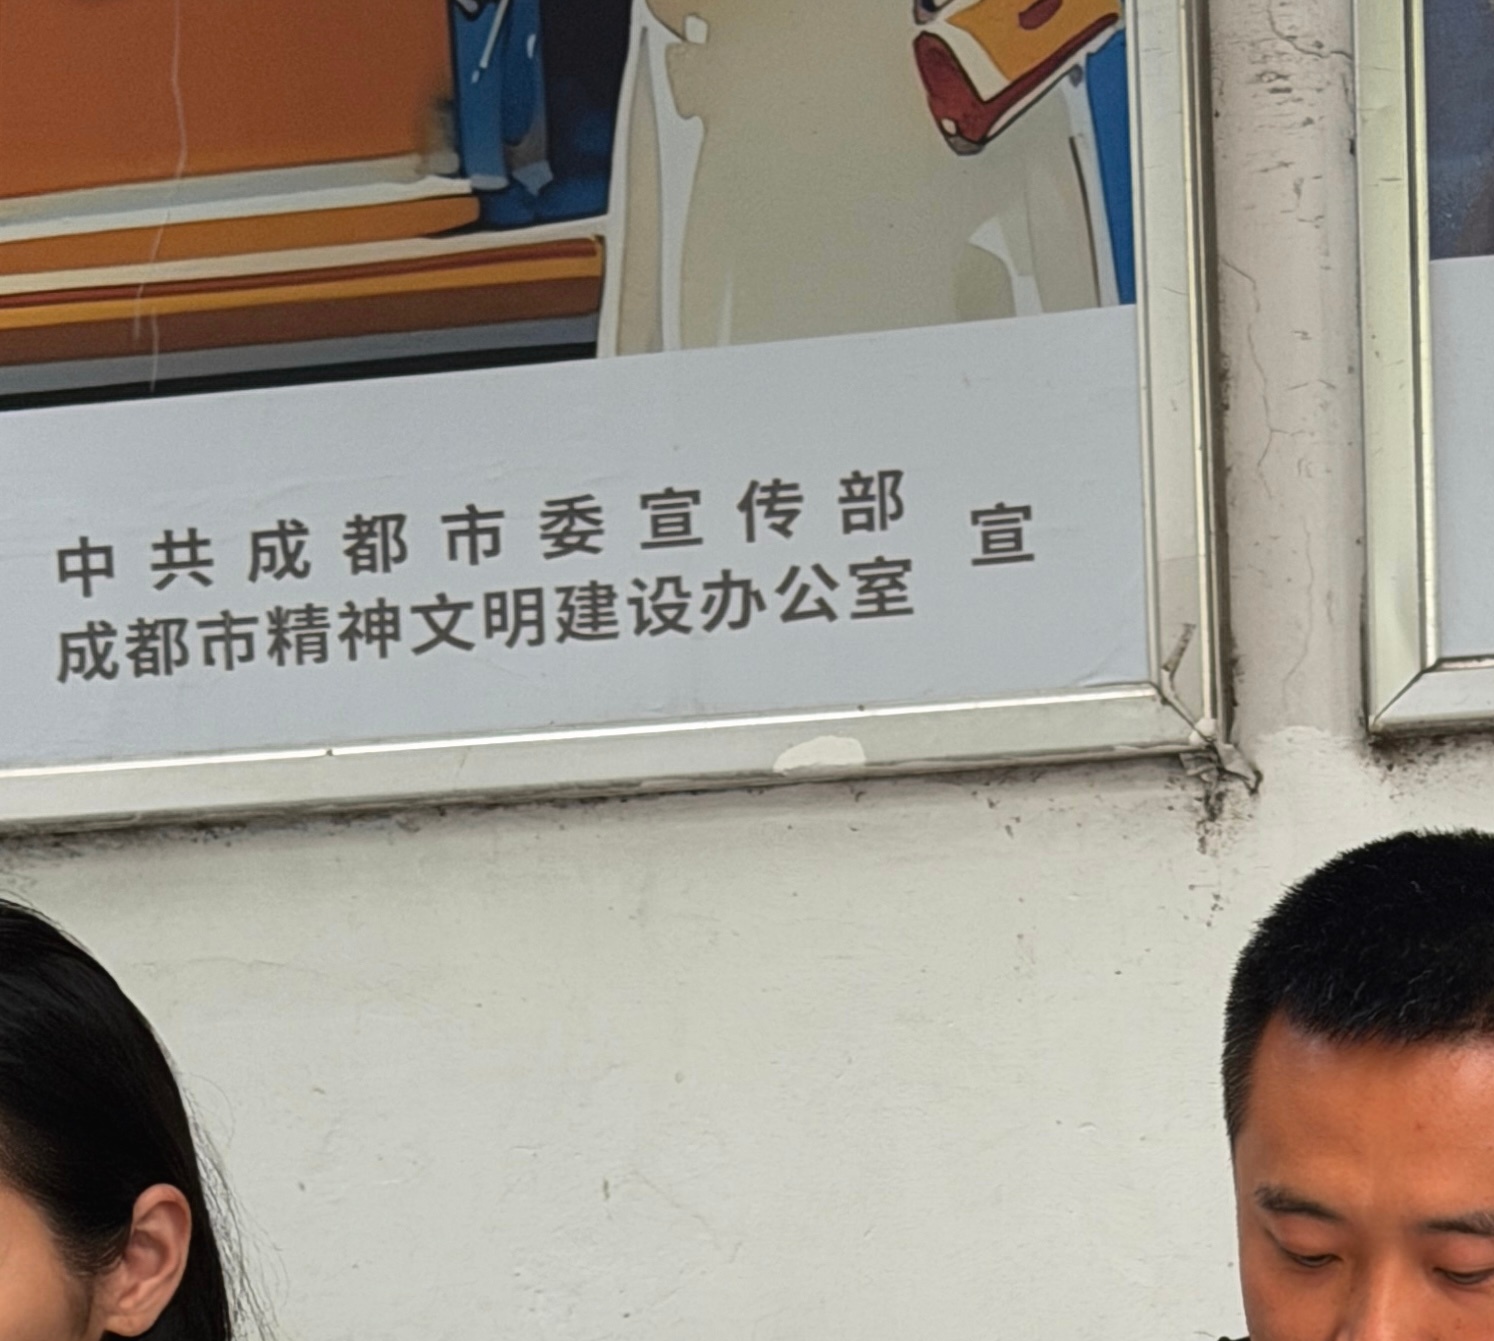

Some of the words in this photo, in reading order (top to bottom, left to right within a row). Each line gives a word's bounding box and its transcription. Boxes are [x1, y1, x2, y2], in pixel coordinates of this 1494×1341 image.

[58, 470, 903, 597] 中共成都市委宣传部
[971, 502, 1034, 565] 宣
[58, 556, 913, 683] 成都市精神文明建设办公室
